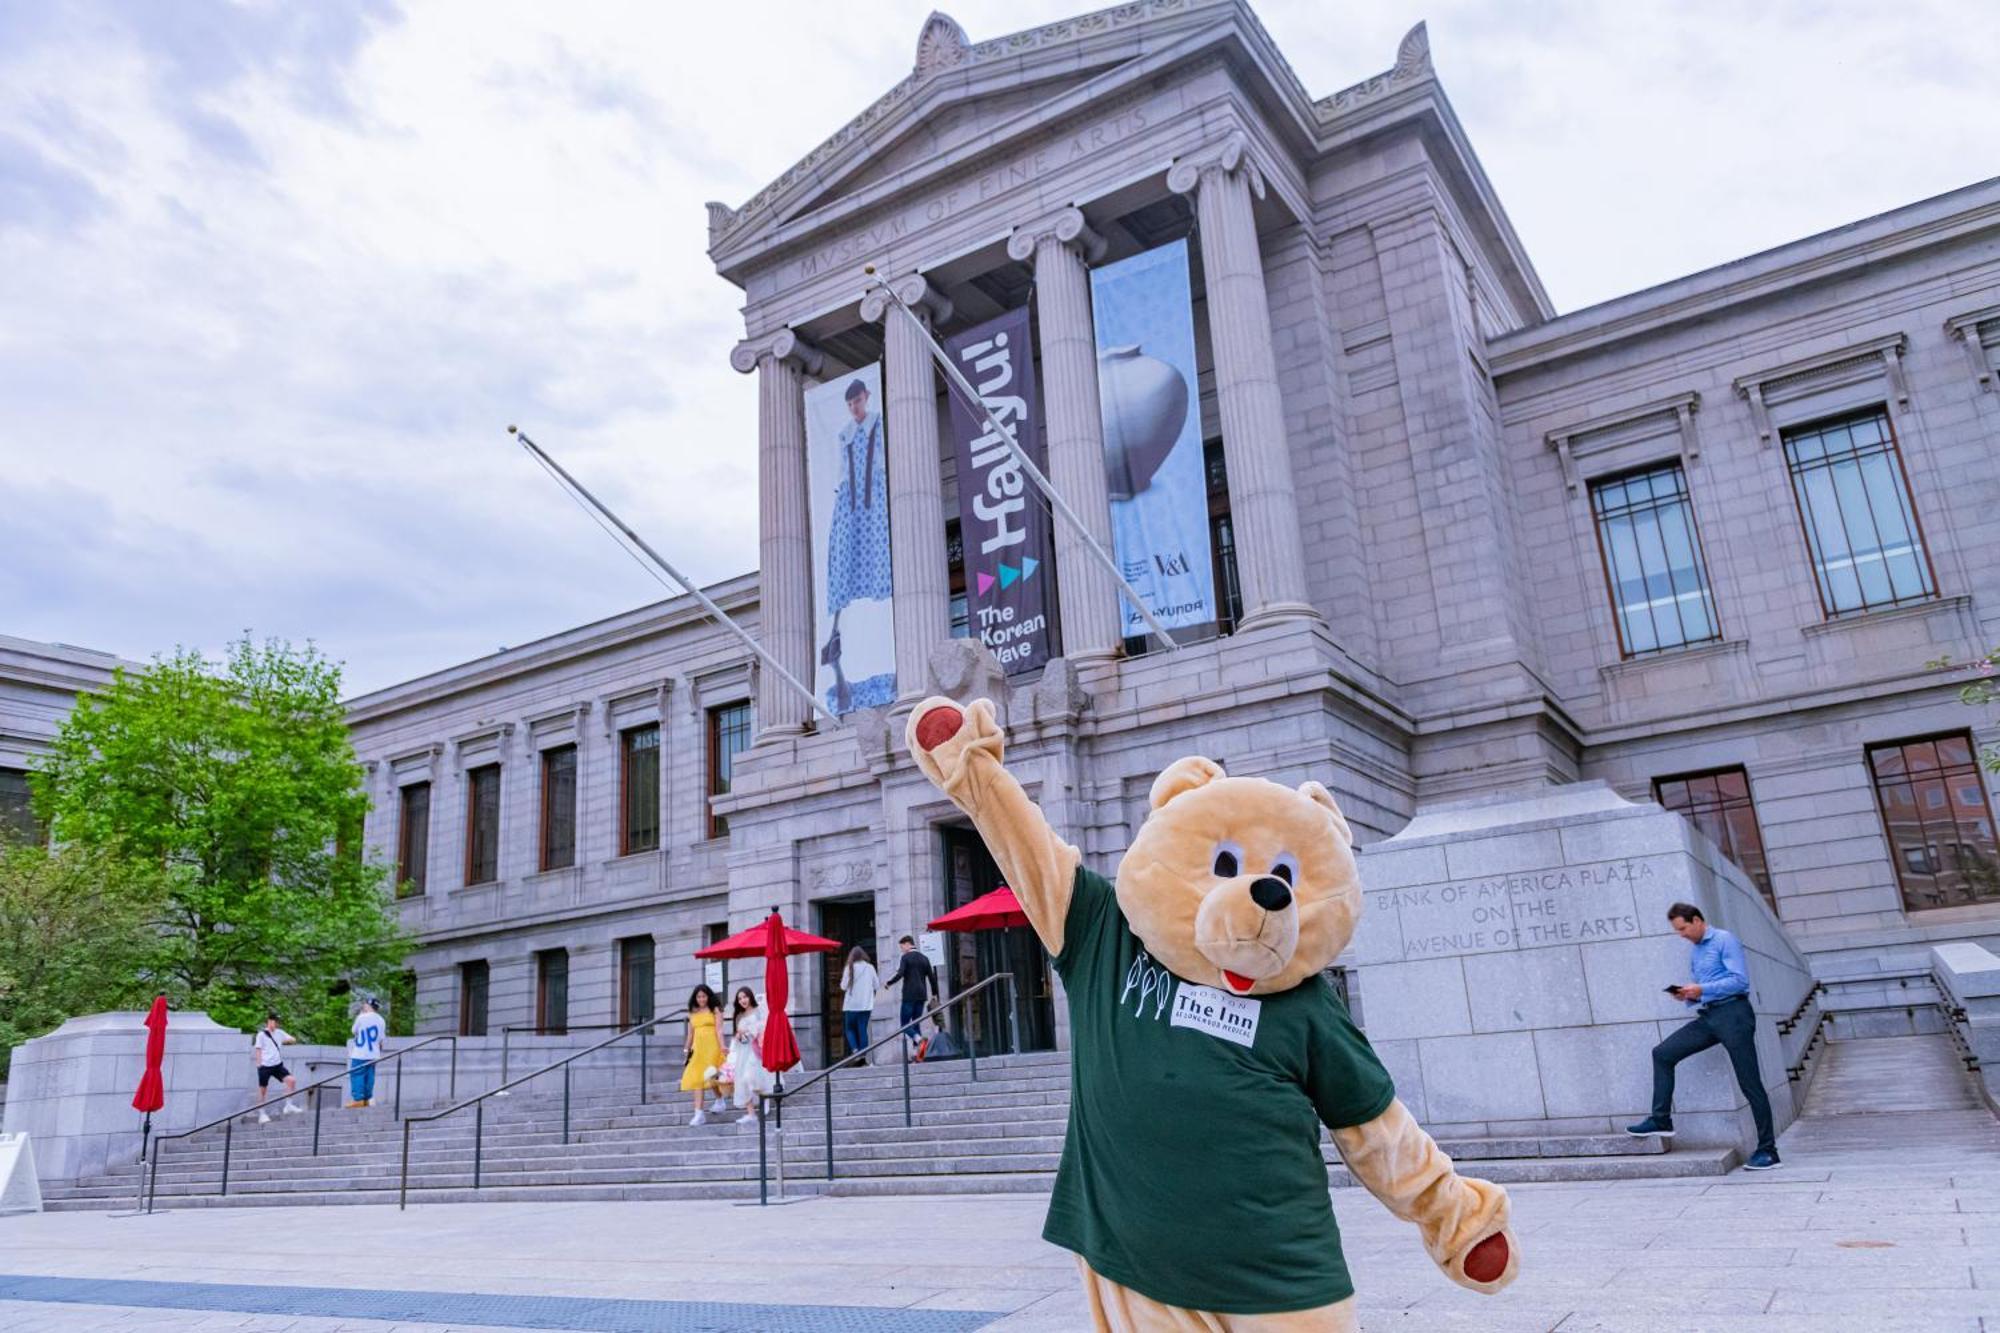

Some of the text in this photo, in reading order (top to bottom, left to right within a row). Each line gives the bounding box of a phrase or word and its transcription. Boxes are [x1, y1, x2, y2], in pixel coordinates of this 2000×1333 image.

[926, 191, 959, 222] OF
[979, 151, 1049, 200] FINE
[1153, 551, 1189, 577] V&A
[977, 605, 1014, 627] The
[981, 614, 1046, 646] Korean
[1377, 863, 1654, 911] BANK OF AMERICA PLAZA
[1472, 899, 1556, 923] ON THE
[1405, 915, 1635, 955] AVENUE OF THE ARTS
[1179, 995, 1253, 1029] The Inn
